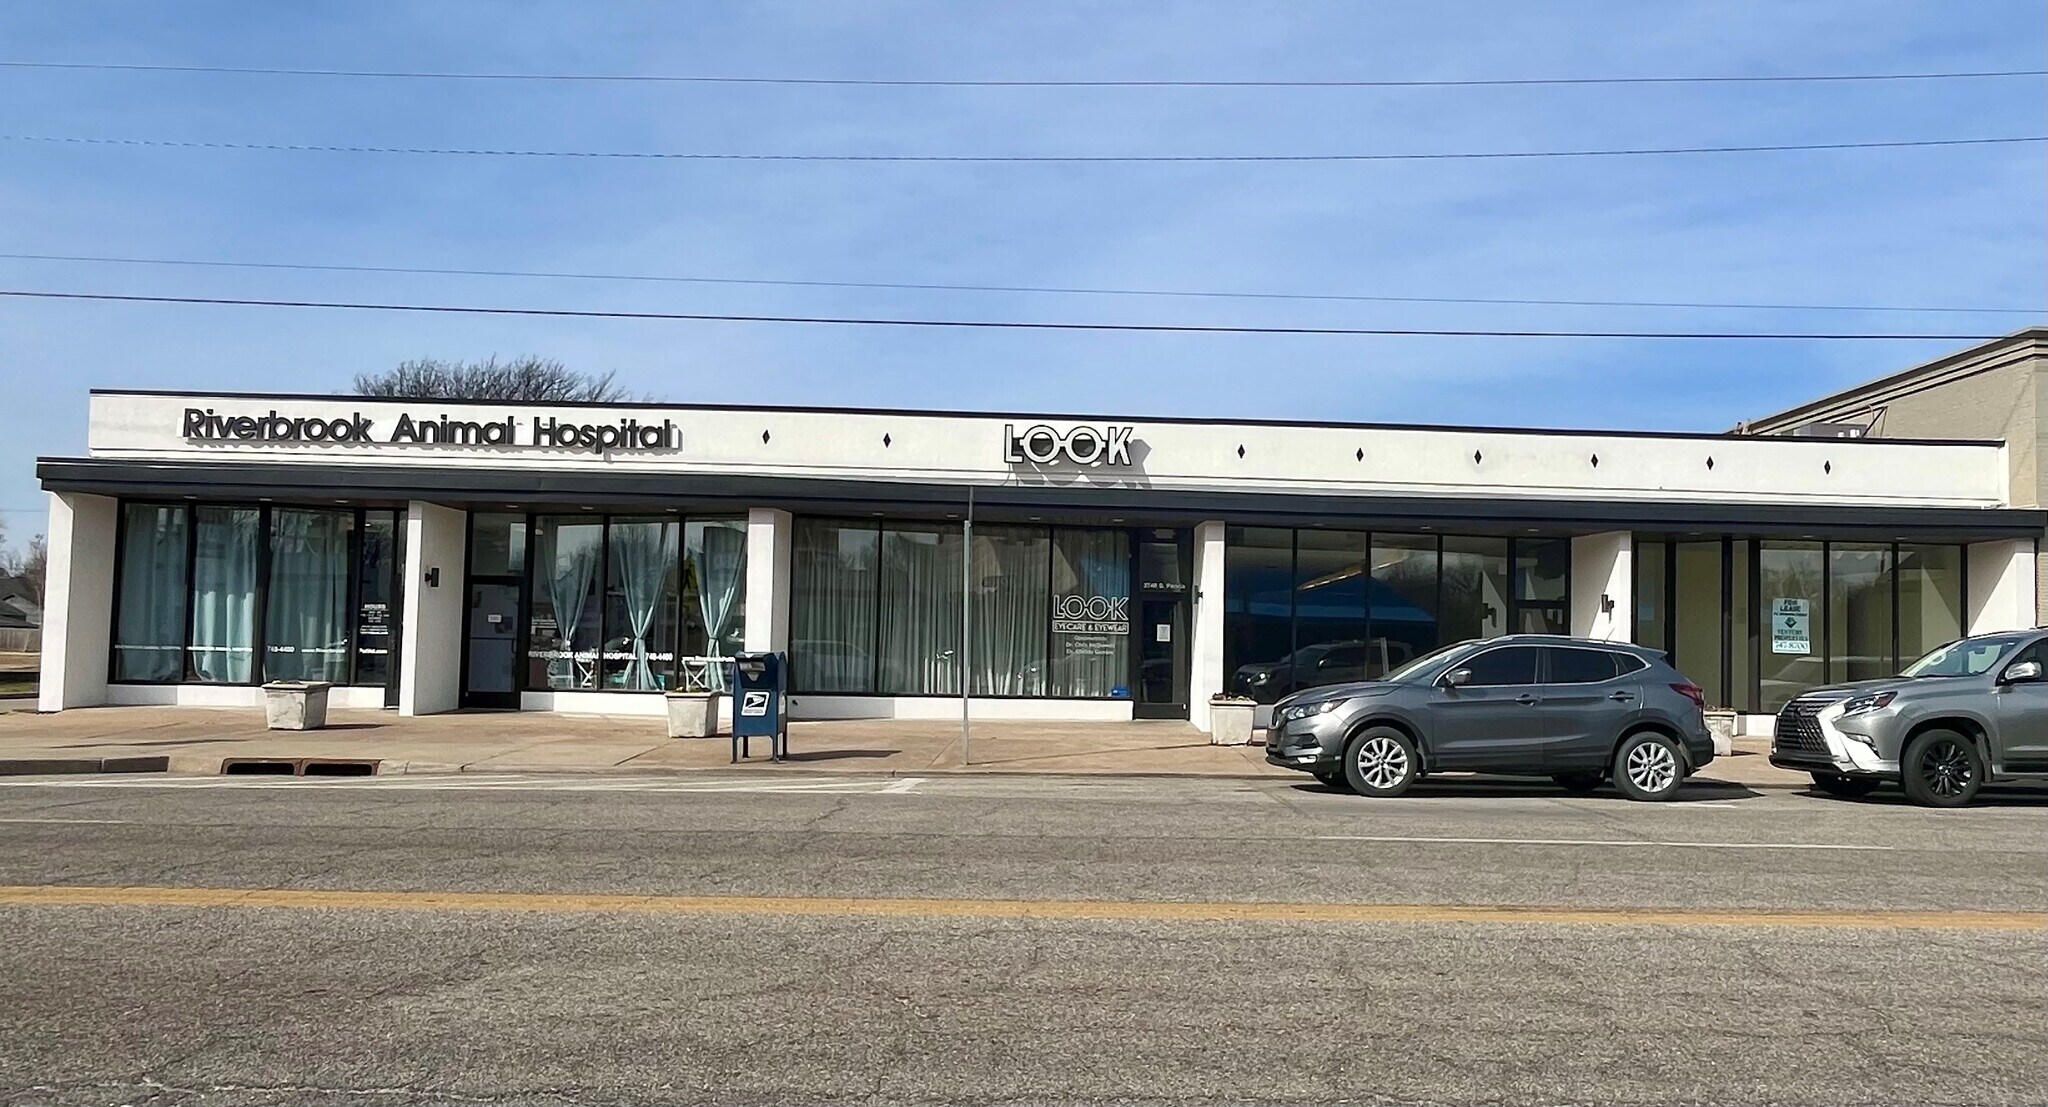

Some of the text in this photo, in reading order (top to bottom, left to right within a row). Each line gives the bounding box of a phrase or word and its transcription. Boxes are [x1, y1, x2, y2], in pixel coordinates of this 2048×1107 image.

[183, 408, 675, 454] Riverbrook Animal Hospital
[1004, 424, 1134, 467] LOOK
[1053, 595, 1129, 620] LOOK
[603, 652, 638, 660] HOSPITAL
